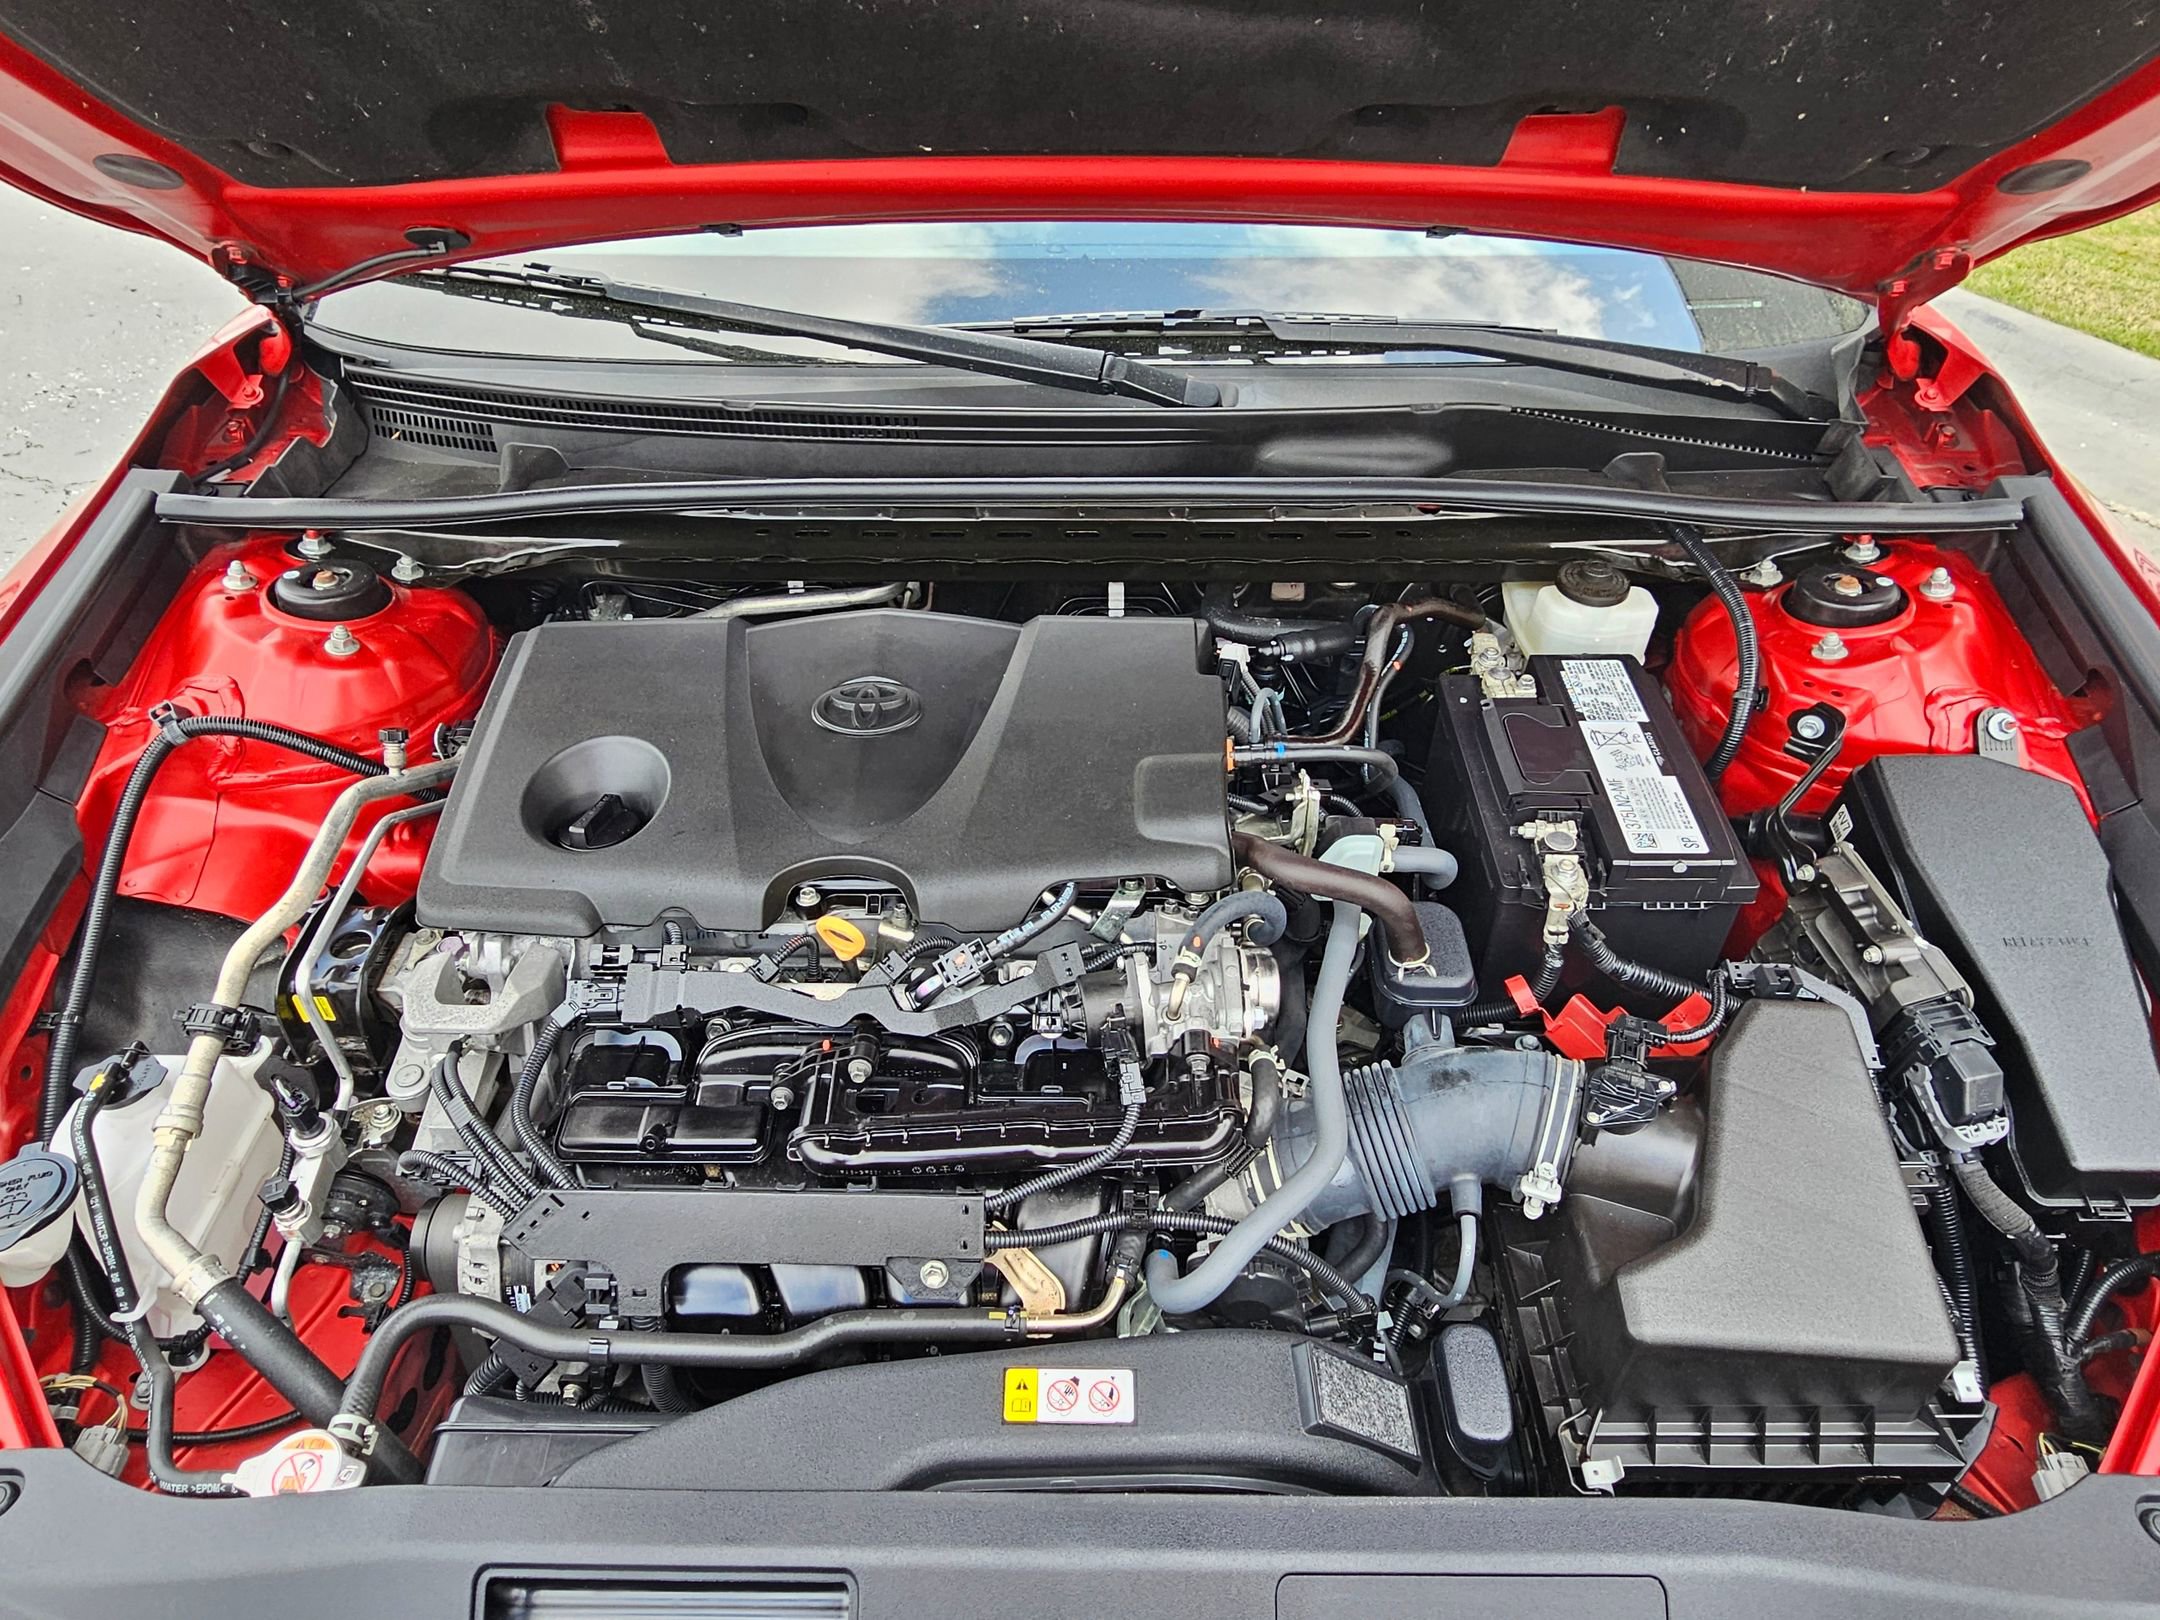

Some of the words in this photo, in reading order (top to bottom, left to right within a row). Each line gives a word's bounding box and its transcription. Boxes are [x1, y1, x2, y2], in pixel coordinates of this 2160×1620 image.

[1606, 778, 1642, 830] 375LN2-MF
[1683, 837, 1700, 849] SP
[159, 1480, 189, 1493] WATER
